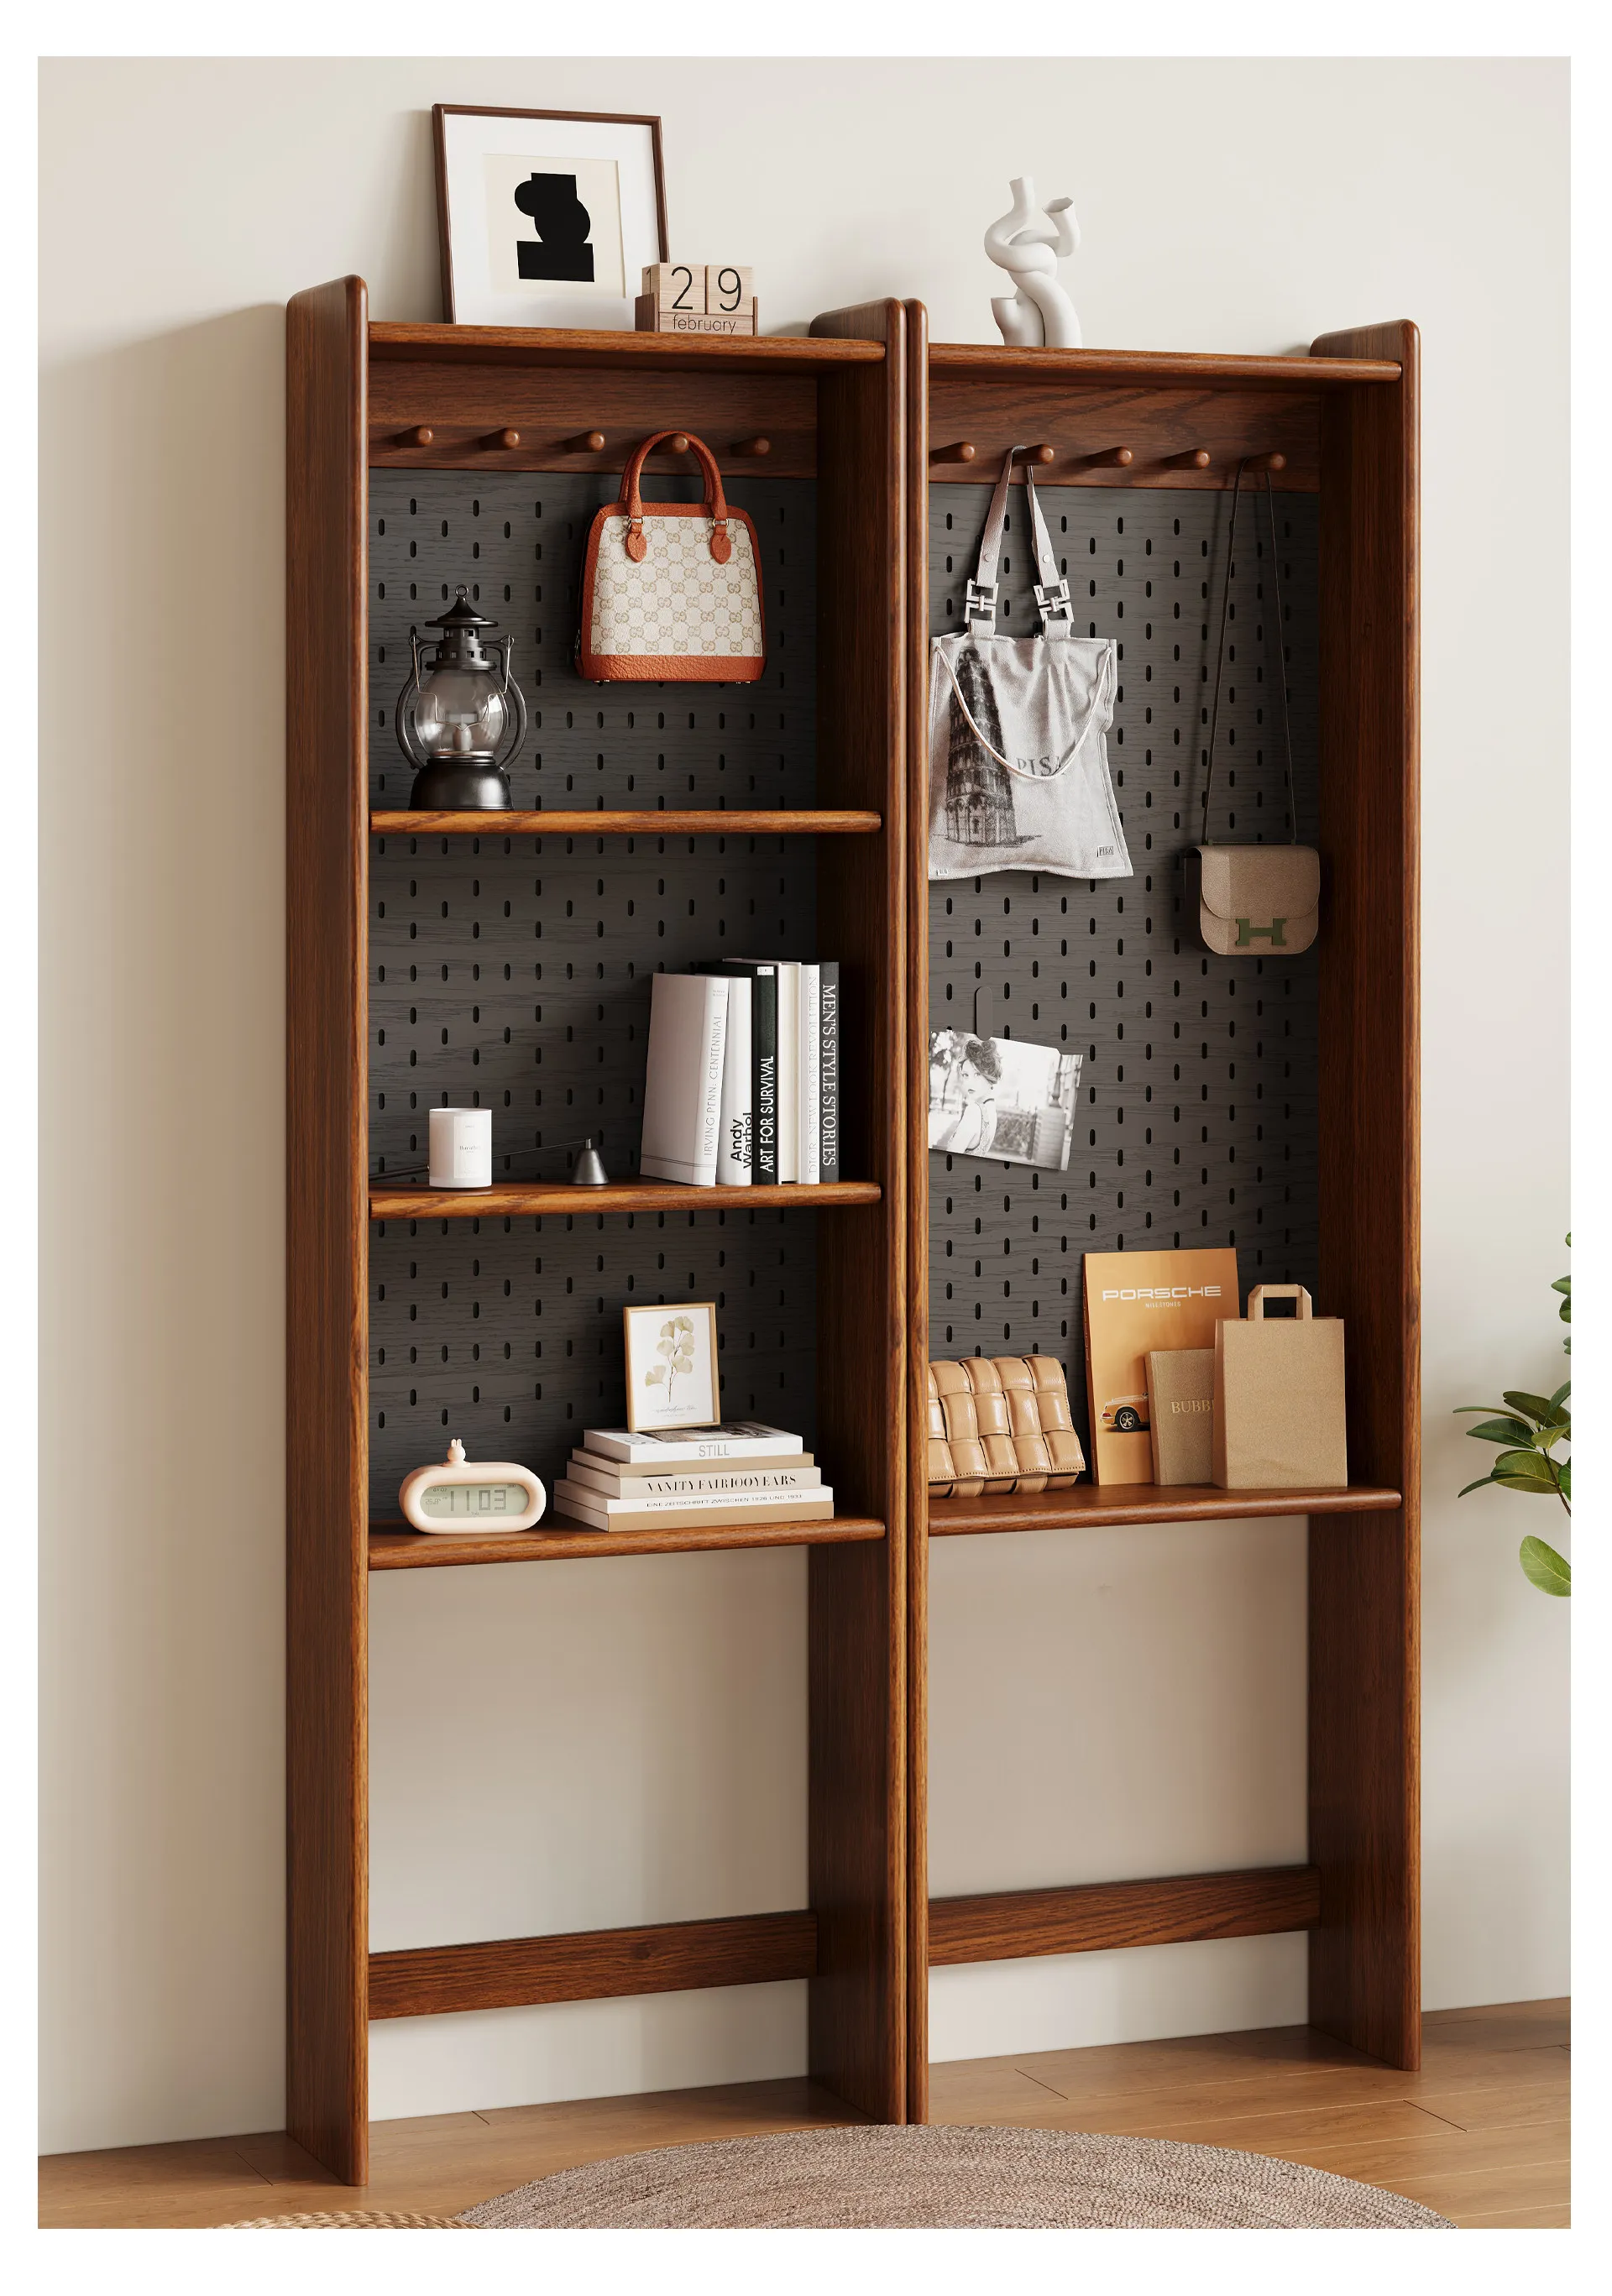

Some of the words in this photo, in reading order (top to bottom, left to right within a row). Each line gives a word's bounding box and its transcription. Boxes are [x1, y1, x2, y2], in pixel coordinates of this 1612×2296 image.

[673, 314, 736, 335] february
[809, 976, 818, 1062] REVOLUTION
[822, 984, 836, 1036] MEN'S
[704, 1117, 714, 1156] IRVING
[709, 1015, 722, 1080] CENTENNIAL
[760, 1056, 774, 1114] SURVIVAL
[809, 1064, 818, 1101] LOOK
[822, 1039, 836, 1092] STYLE
[730, 1119, 744, 1162] Andy
[742, 1112, 751, 1169] Warhol
[760, 1117, 774, 1144] FOR
[822, 1096, 836, 1166] STORIES
[760, 1150, 774, 1172] ART
[1102, 1286, 1222, 1302] PORSCHE
[699, 1444, 730, 1457] STILL
